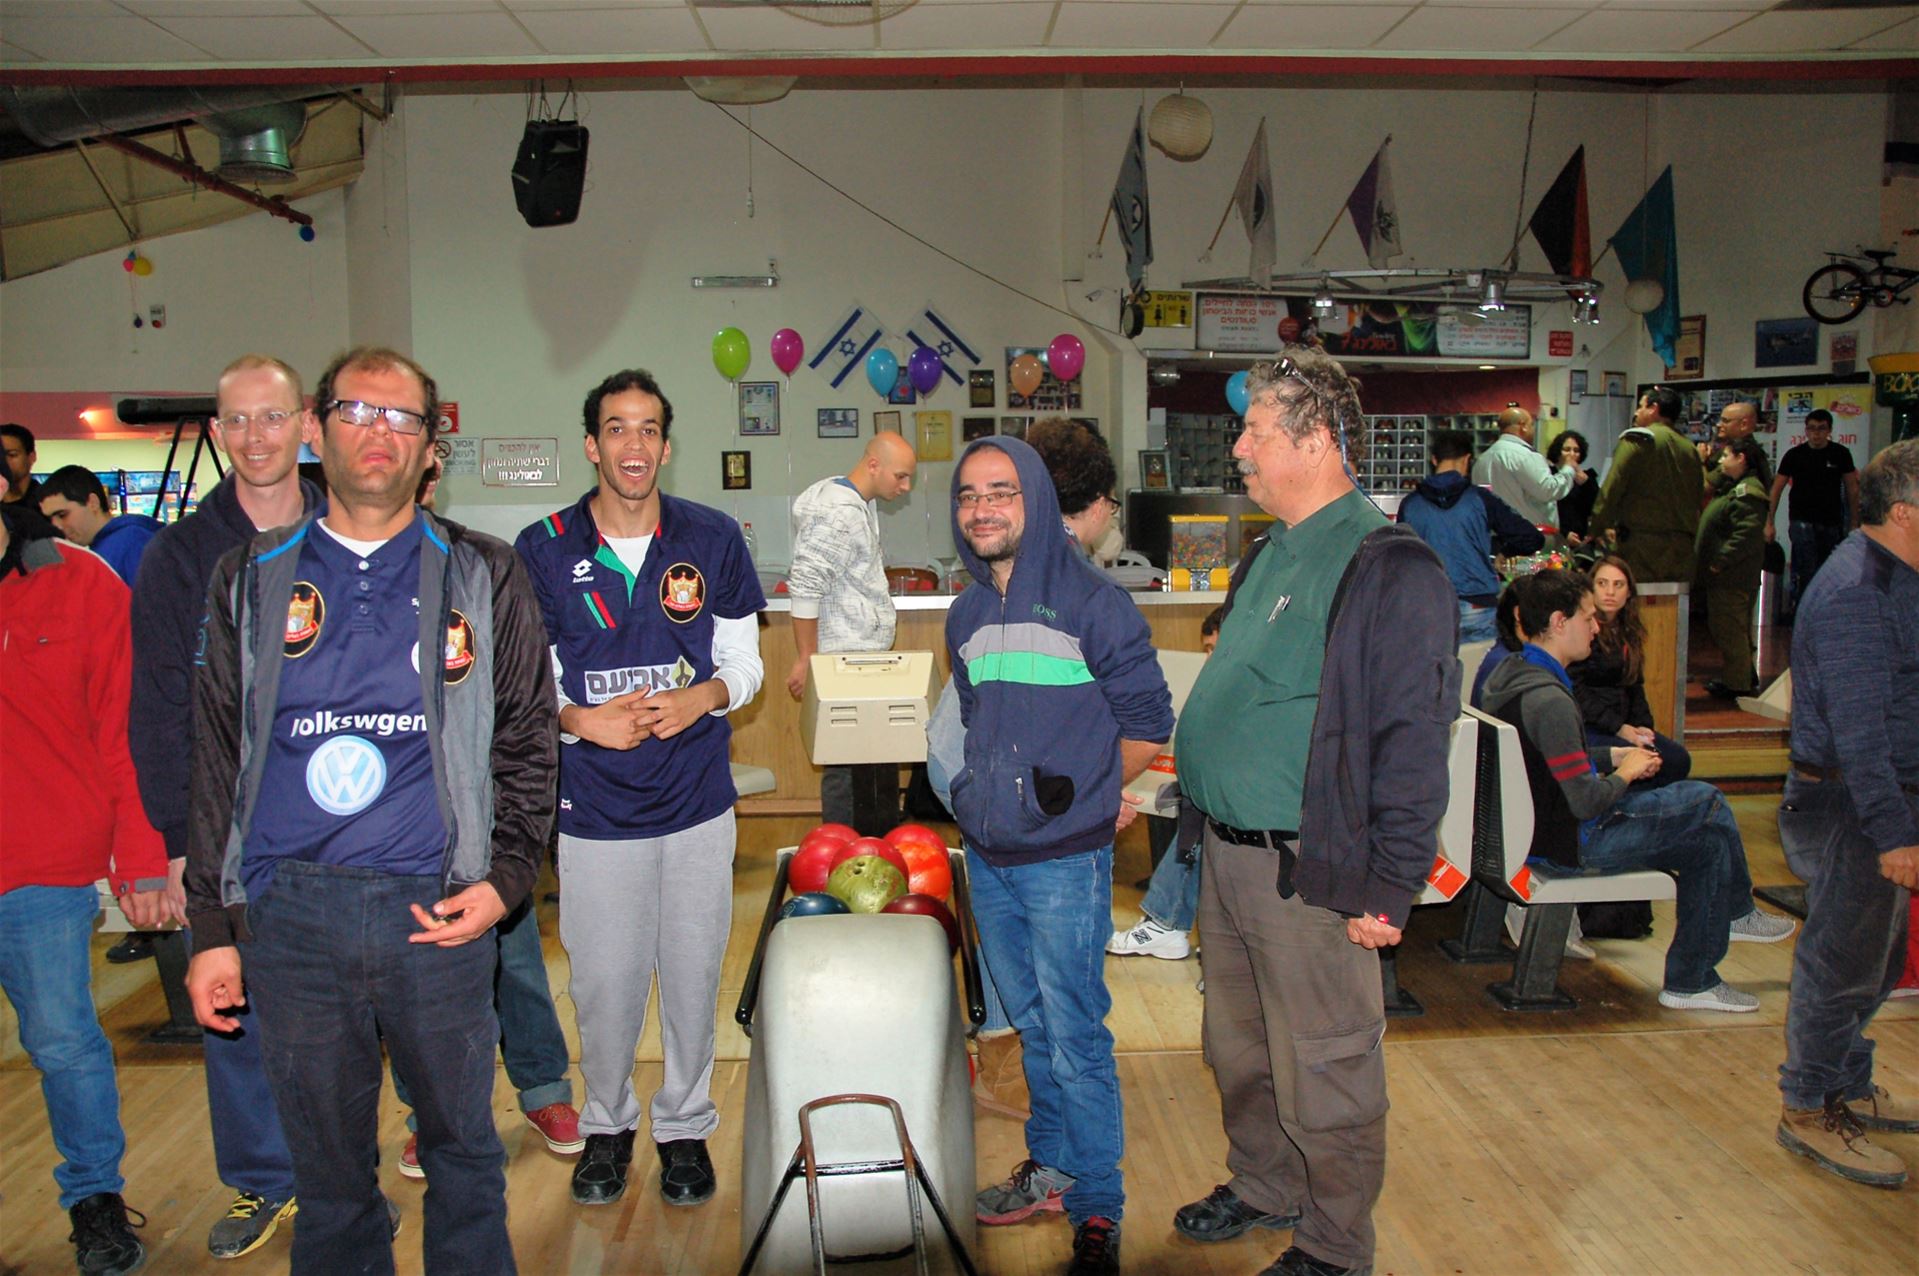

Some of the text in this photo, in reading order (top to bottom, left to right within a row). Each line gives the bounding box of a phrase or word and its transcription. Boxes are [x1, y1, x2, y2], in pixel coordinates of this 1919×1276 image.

[453, 447, 476, 459] לעשן
[532, 456, 550, 467] דברי
[586, 666, 671, 695] אביעם
